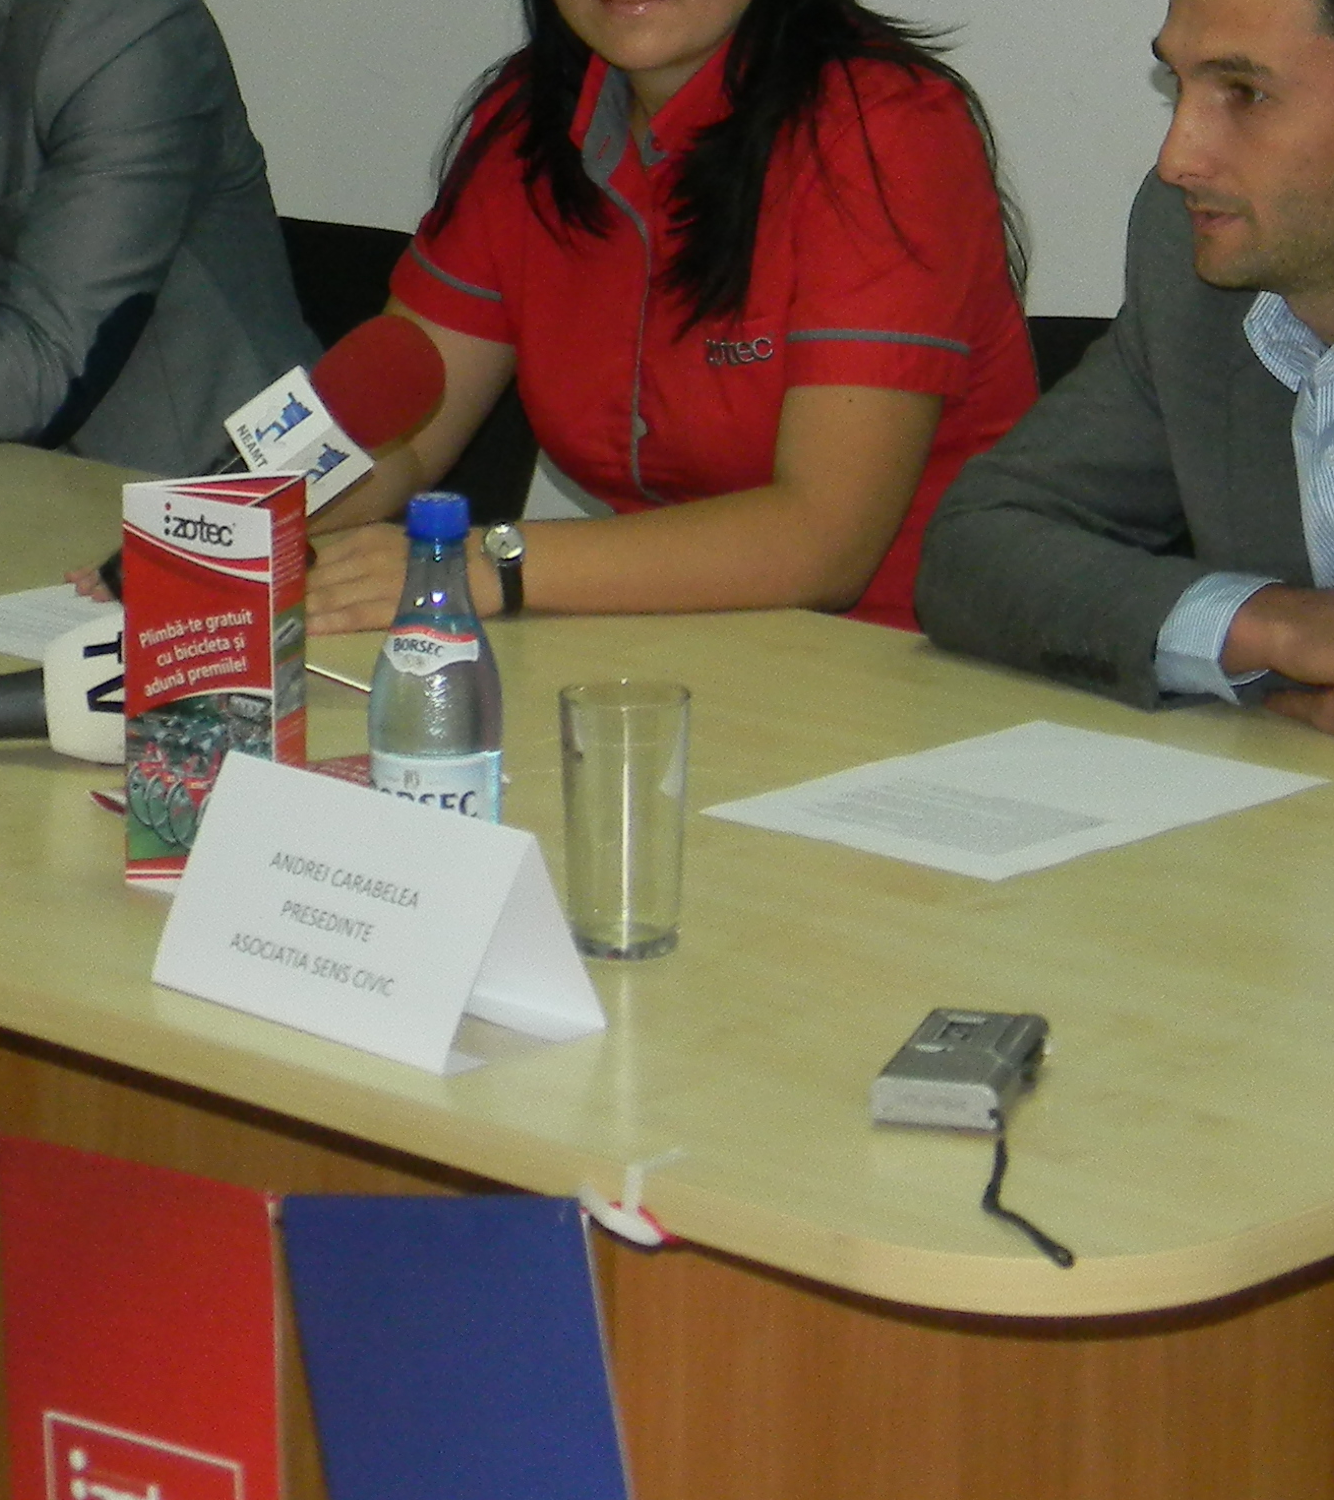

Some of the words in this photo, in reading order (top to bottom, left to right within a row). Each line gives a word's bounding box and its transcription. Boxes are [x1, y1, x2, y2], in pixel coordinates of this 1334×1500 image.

[138, 617, 204, 648] Plimbă-te
[205, 608, 253, 633] gratuit
[393, 637, 445, 658] BORSEC
[156, 651, 172, 667] cu
[174, 633, 231, 659] bicicleta
[144, 668, 185, 697] adună
[187, 656, 248, 686] premiile!
[269, 852, 330, 882] ANDREI
[331, 869, 418, 908] CARABELEA
[280, 899, 374, 942] PRESEDINTE
[230, 933, 308, 969] ASOCIATIA
[311, 956, 352, 984] SENS
[353, 969, 394, 997] CIVIC
